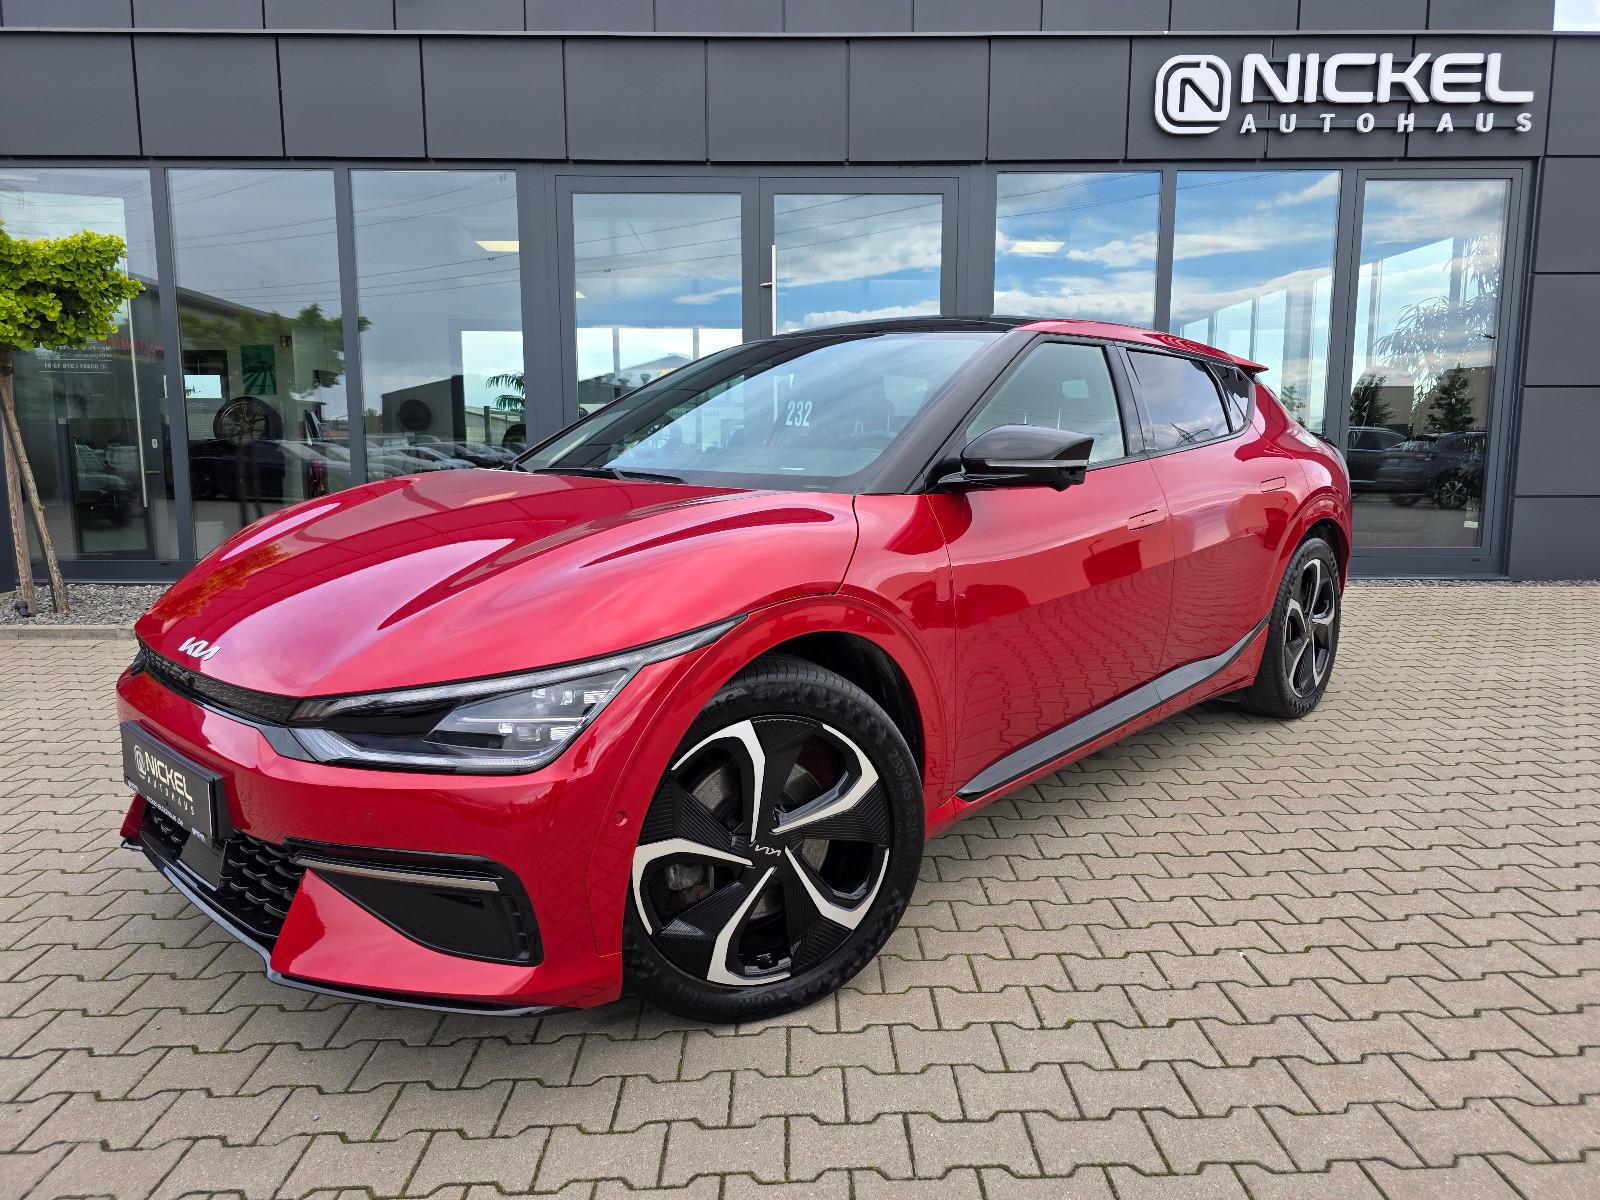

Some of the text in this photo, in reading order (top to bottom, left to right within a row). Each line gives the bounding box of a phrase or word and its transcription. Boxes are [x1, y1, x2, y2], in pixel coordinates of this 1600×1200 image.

[1240, 52, 1534, 104] NICKEL
[1239, 112, 1532, 134] AUTOHAUS
[786, 401, 812, 427] 232
[178, 636, 221, 661] KIA
[144, 751, 193, 802] NICKEL
[147, 776, 195, 815] AUTOHAUS
